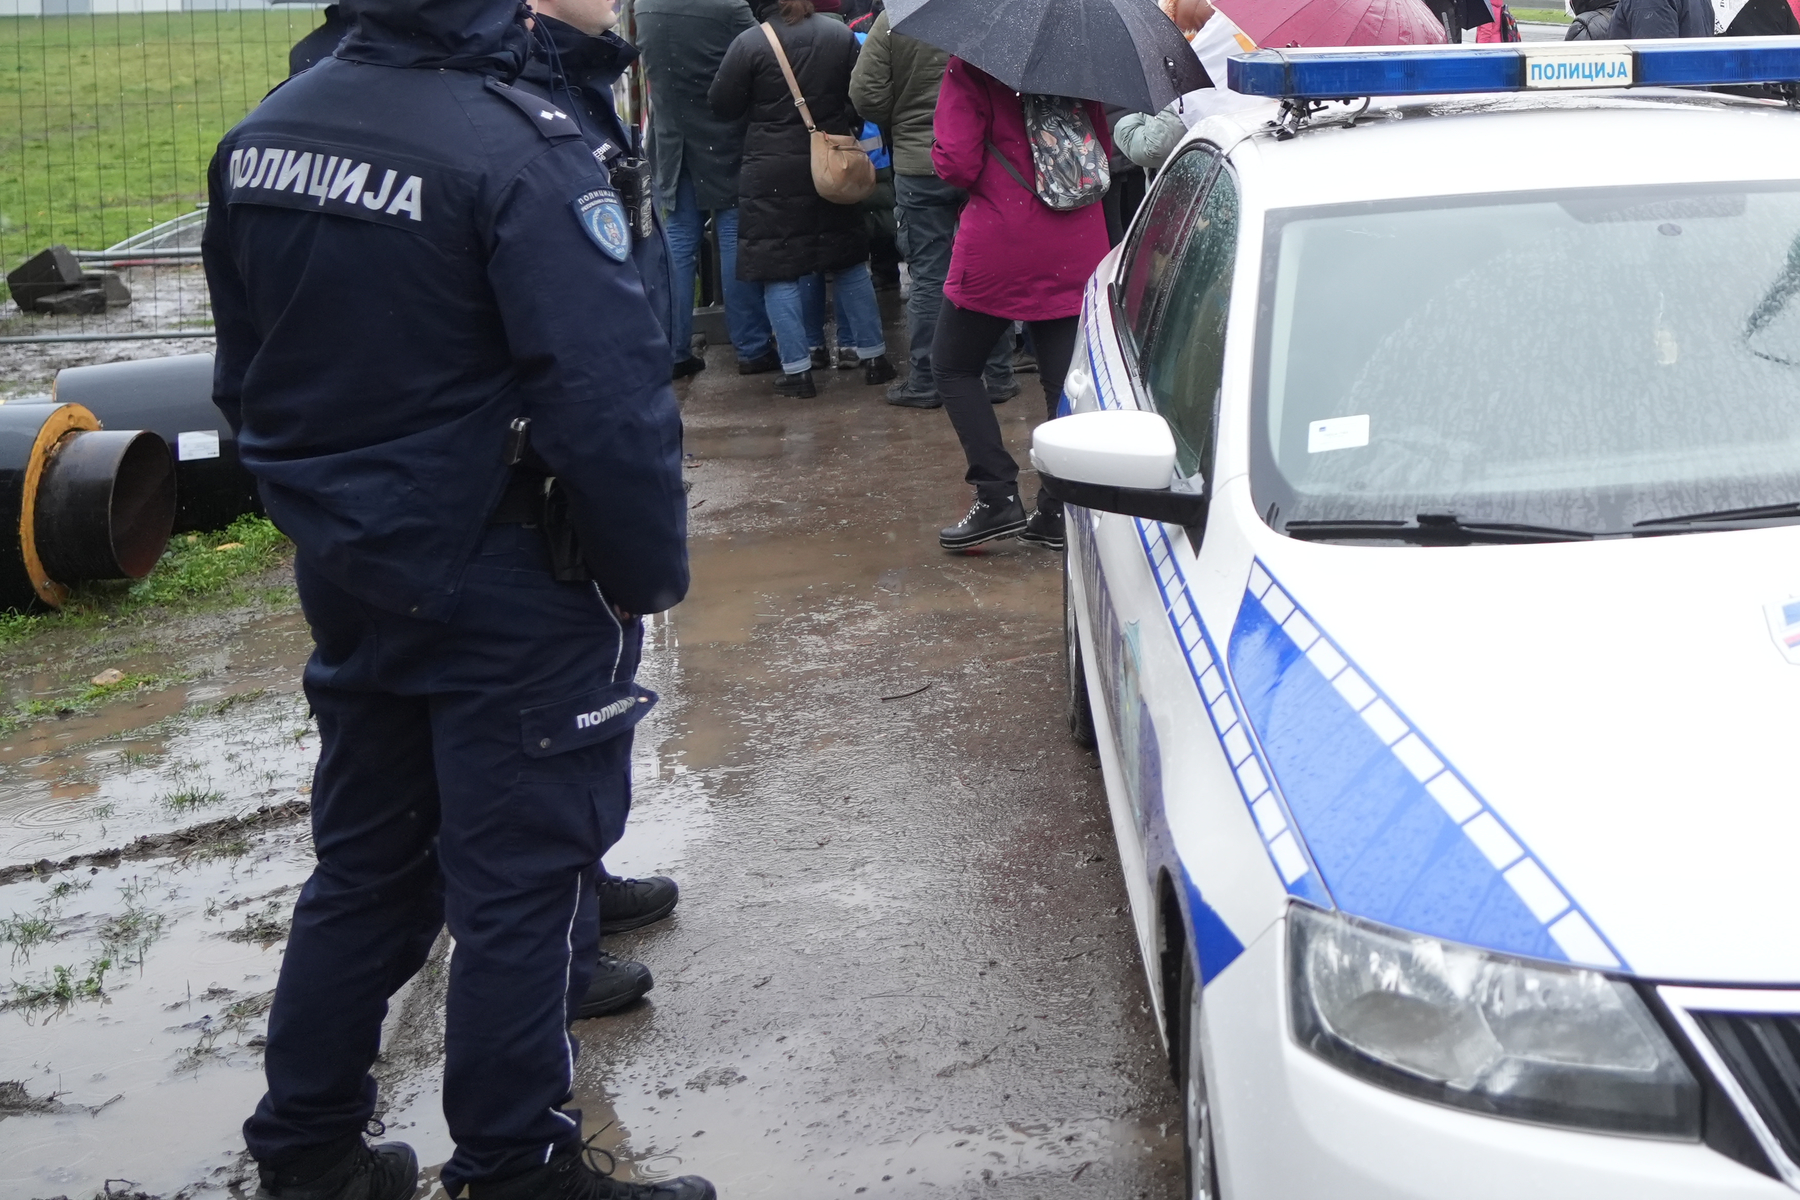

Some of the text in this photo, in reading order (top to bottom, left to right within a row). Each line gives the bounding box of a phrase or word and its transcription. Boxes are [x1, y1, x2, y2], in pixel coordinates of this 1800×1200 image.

[1531, 61, 1628, 82] ПОЛИЦИЈА
[229, 146, 423, 222] ПОЛИЦИЈА
[577, 189, 615, 205] ПОЛИЦИЈА
